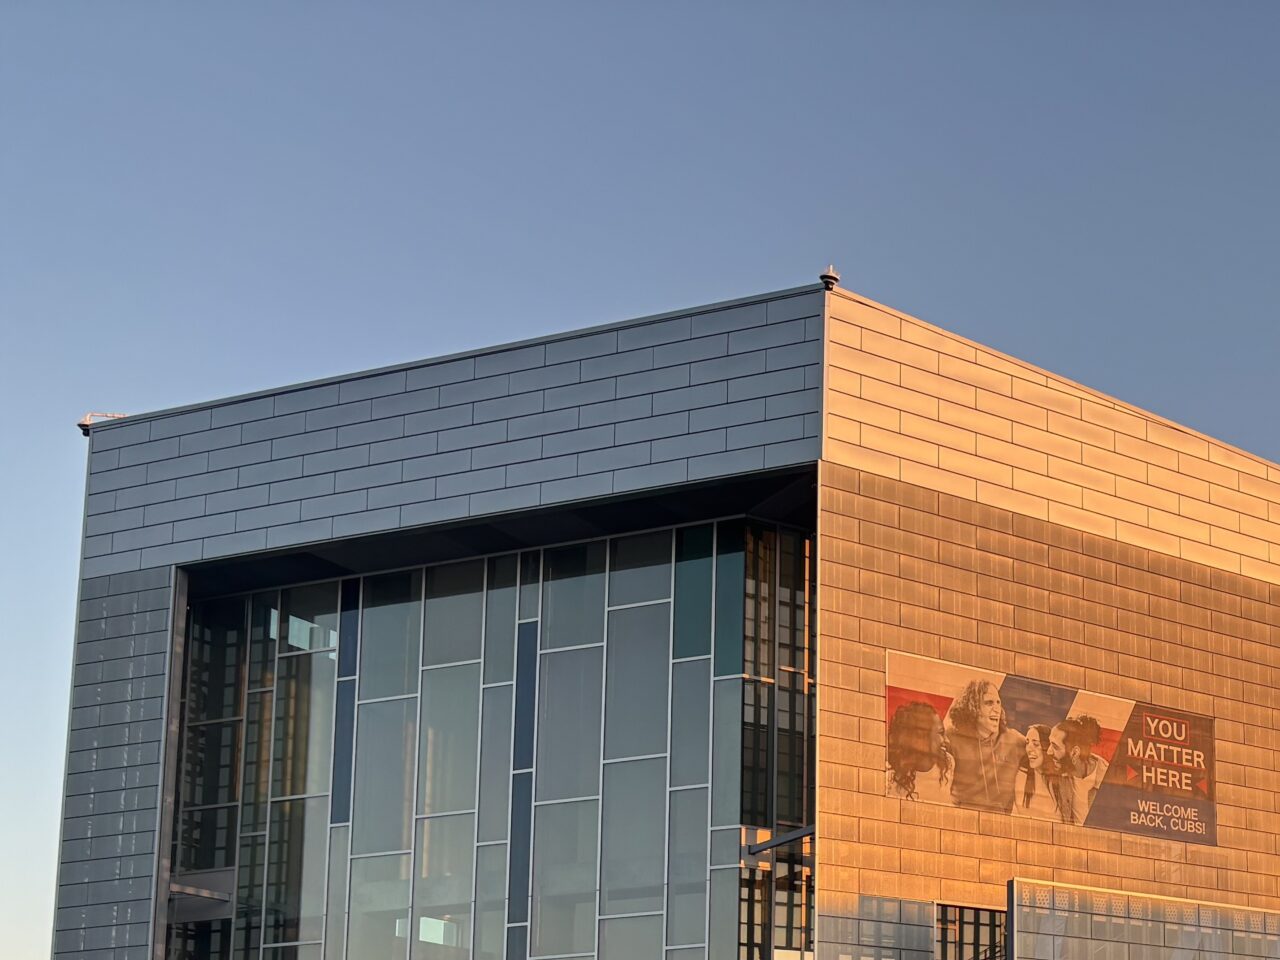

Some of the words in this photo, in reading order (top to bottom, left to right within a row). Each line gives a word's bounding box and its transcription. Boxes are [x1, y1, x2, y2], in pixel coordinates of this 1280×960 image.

[1146, 716, 1186, 741] YOU
[1127, 738, 1205, 769] MATTER
[1142, 765, 1192, 791] HERE
[1137, 799, 1198, 820] WELCOME
[1130, 811, 1167, 830] BACK,
[1170, 818, 1206, 834] CUBS!
